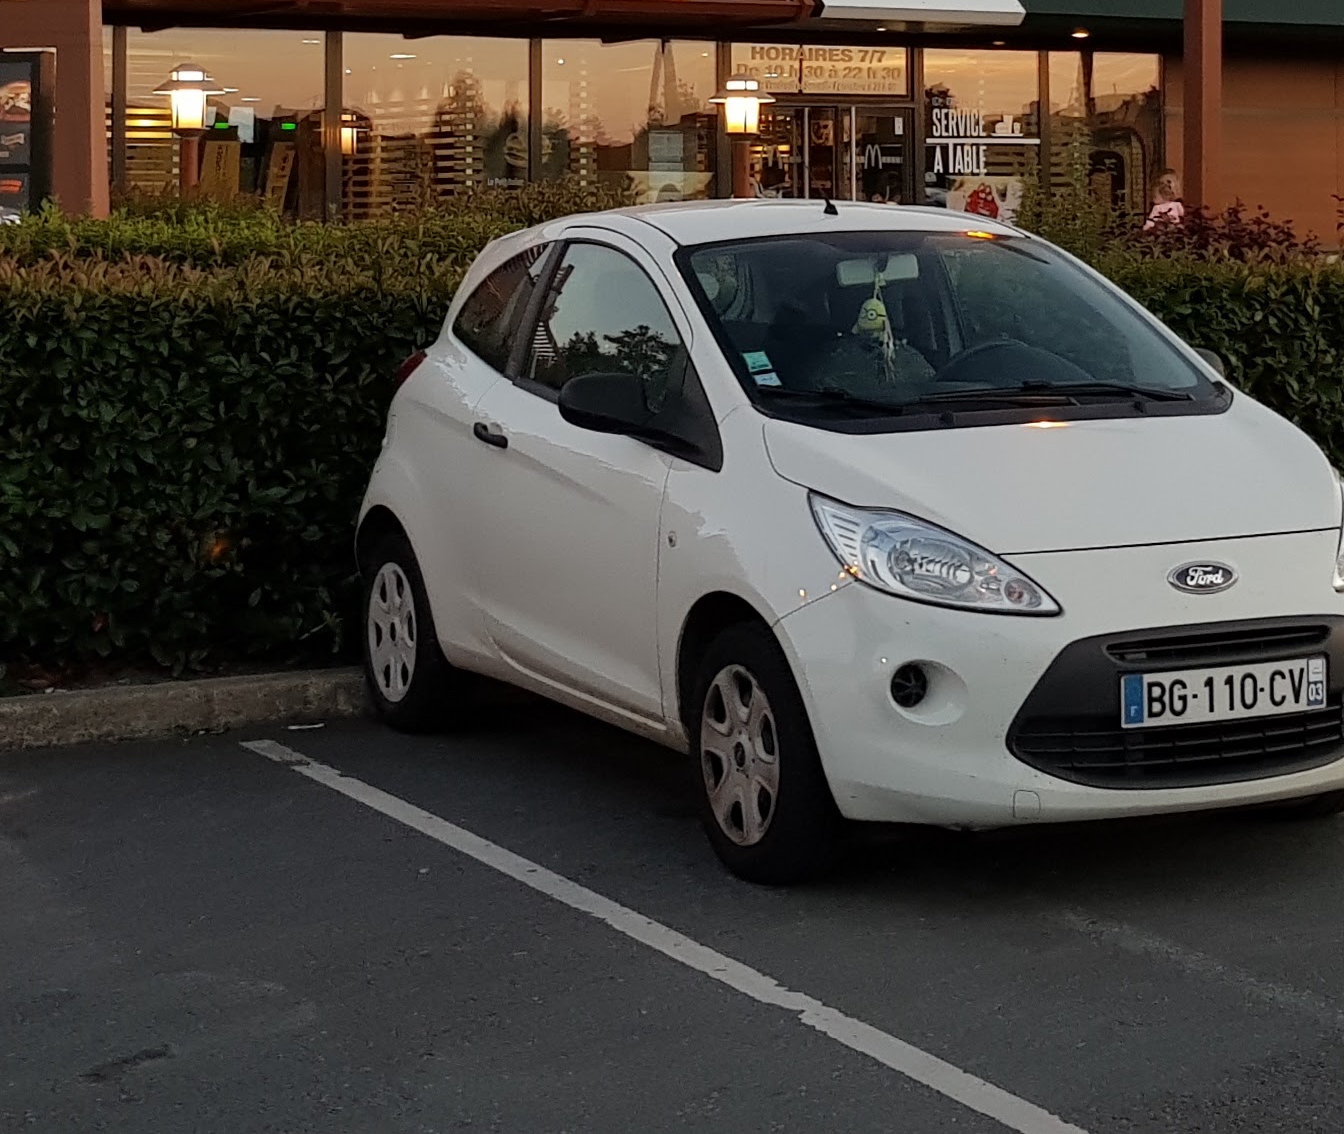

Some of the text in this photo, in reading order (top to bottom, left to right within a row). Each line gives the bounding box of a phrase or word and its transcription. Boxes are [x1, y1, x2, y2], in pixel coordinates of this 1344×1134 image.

[750, 46, 887, 64] HORAIRES 7/7
[789, 64, 798, 78] h
[804, 65, 824, 79] 30
[828, 64, 838, 79] à
[843, 66, 862, 79] 22
[881, 67, 901, 80] 30
[932, 108, 988, 137] SERVICE
[933, 141, 988, 174] A TABLE
[1186, 565, 1225, 586] Ford
[1146, 667, 1305, 718] BG-110-CV
[1308, 684, 1323, 701] 03
